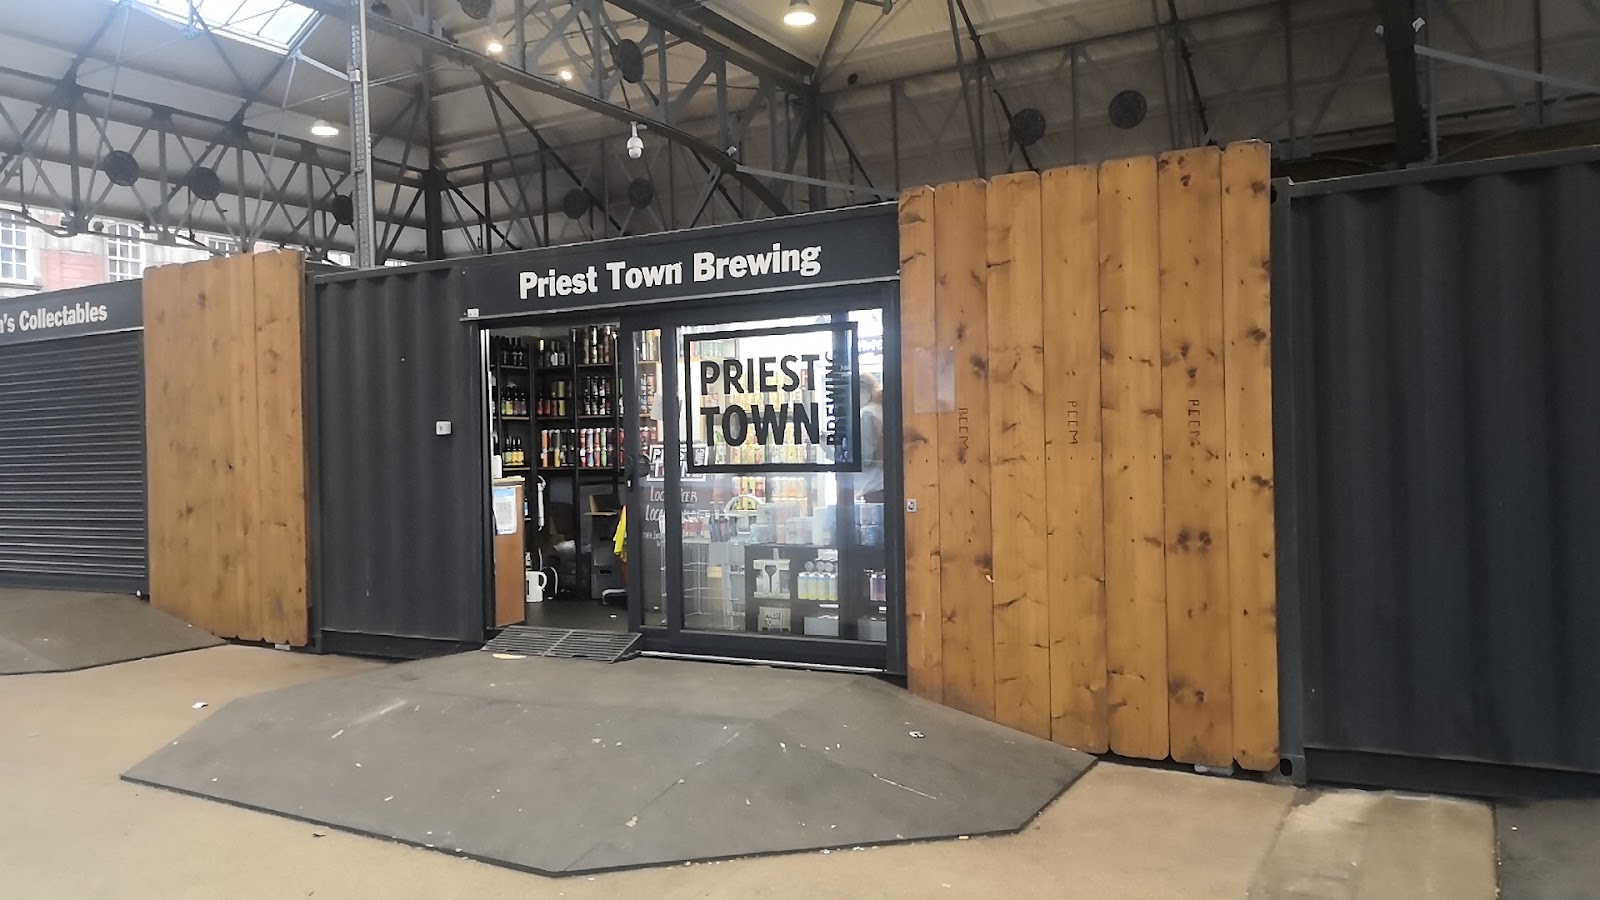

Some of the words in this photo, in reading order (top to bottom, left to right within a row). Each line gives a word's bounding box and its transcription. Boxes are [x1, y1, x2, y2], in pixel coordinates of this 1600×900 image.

[519, 269, 598, 299] Priest
[606, 261, 683, 290] Town
[693, 243, 822, 282] Brewing
[19, 301, 108, 331] Collectables
[700, 354, 820, 396] PRIEST
[700, 402, 821, 447] TOWN
